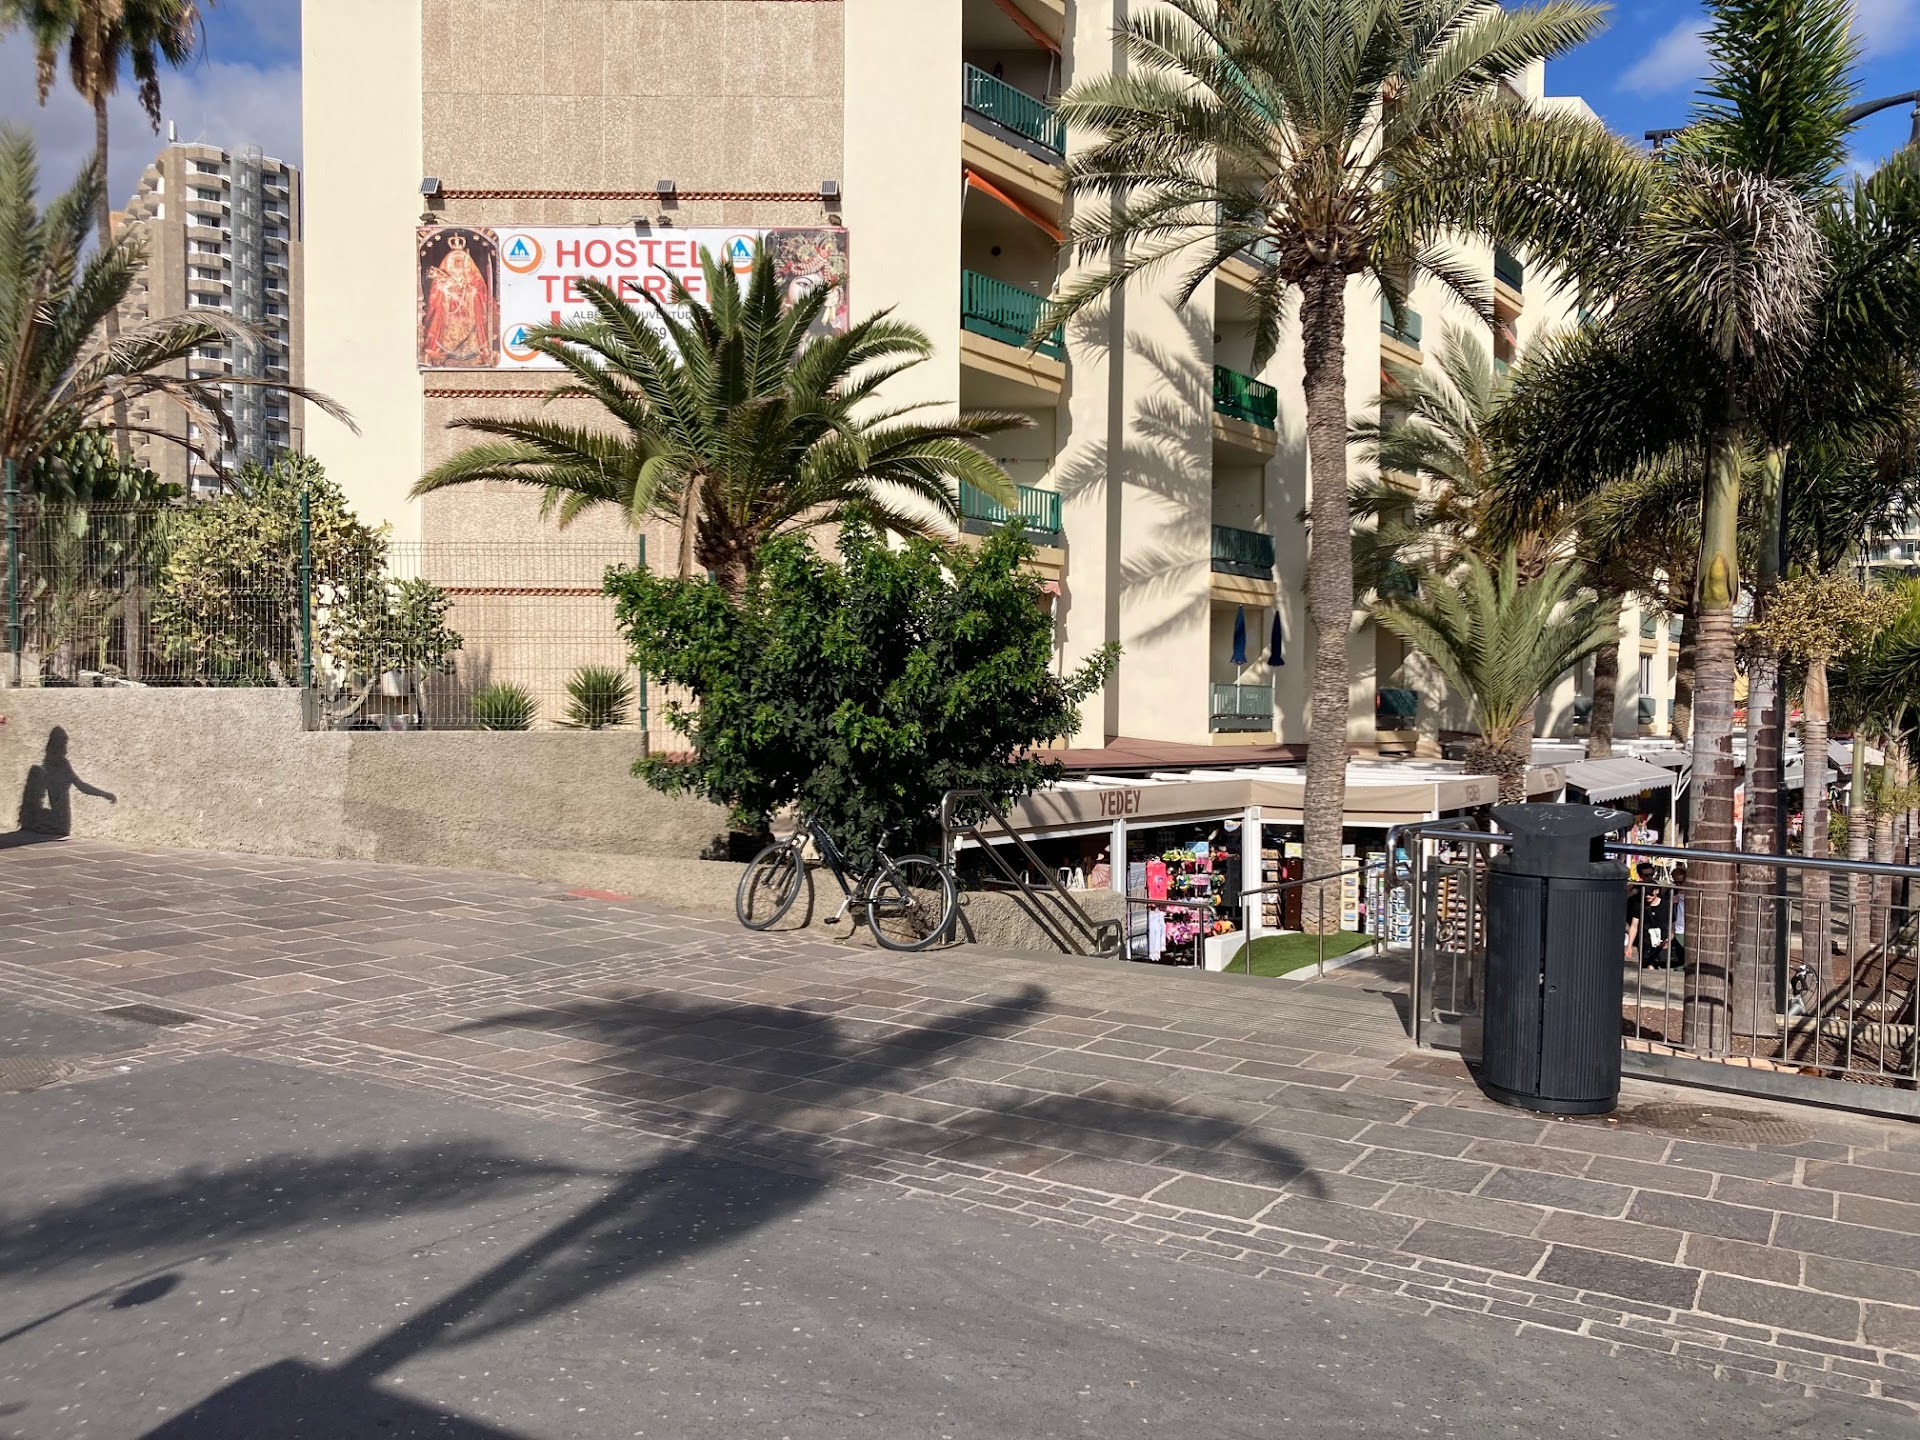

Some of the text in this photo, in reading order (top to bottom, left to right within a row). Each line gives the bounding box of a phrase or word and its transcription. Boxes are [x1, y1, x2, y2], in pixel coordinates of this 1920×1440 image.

[556, 239, 704, 268] HOSTEL
[537, 275, 712, 304] TEERF
[1099, 789, 1141, 816] YEDEY
